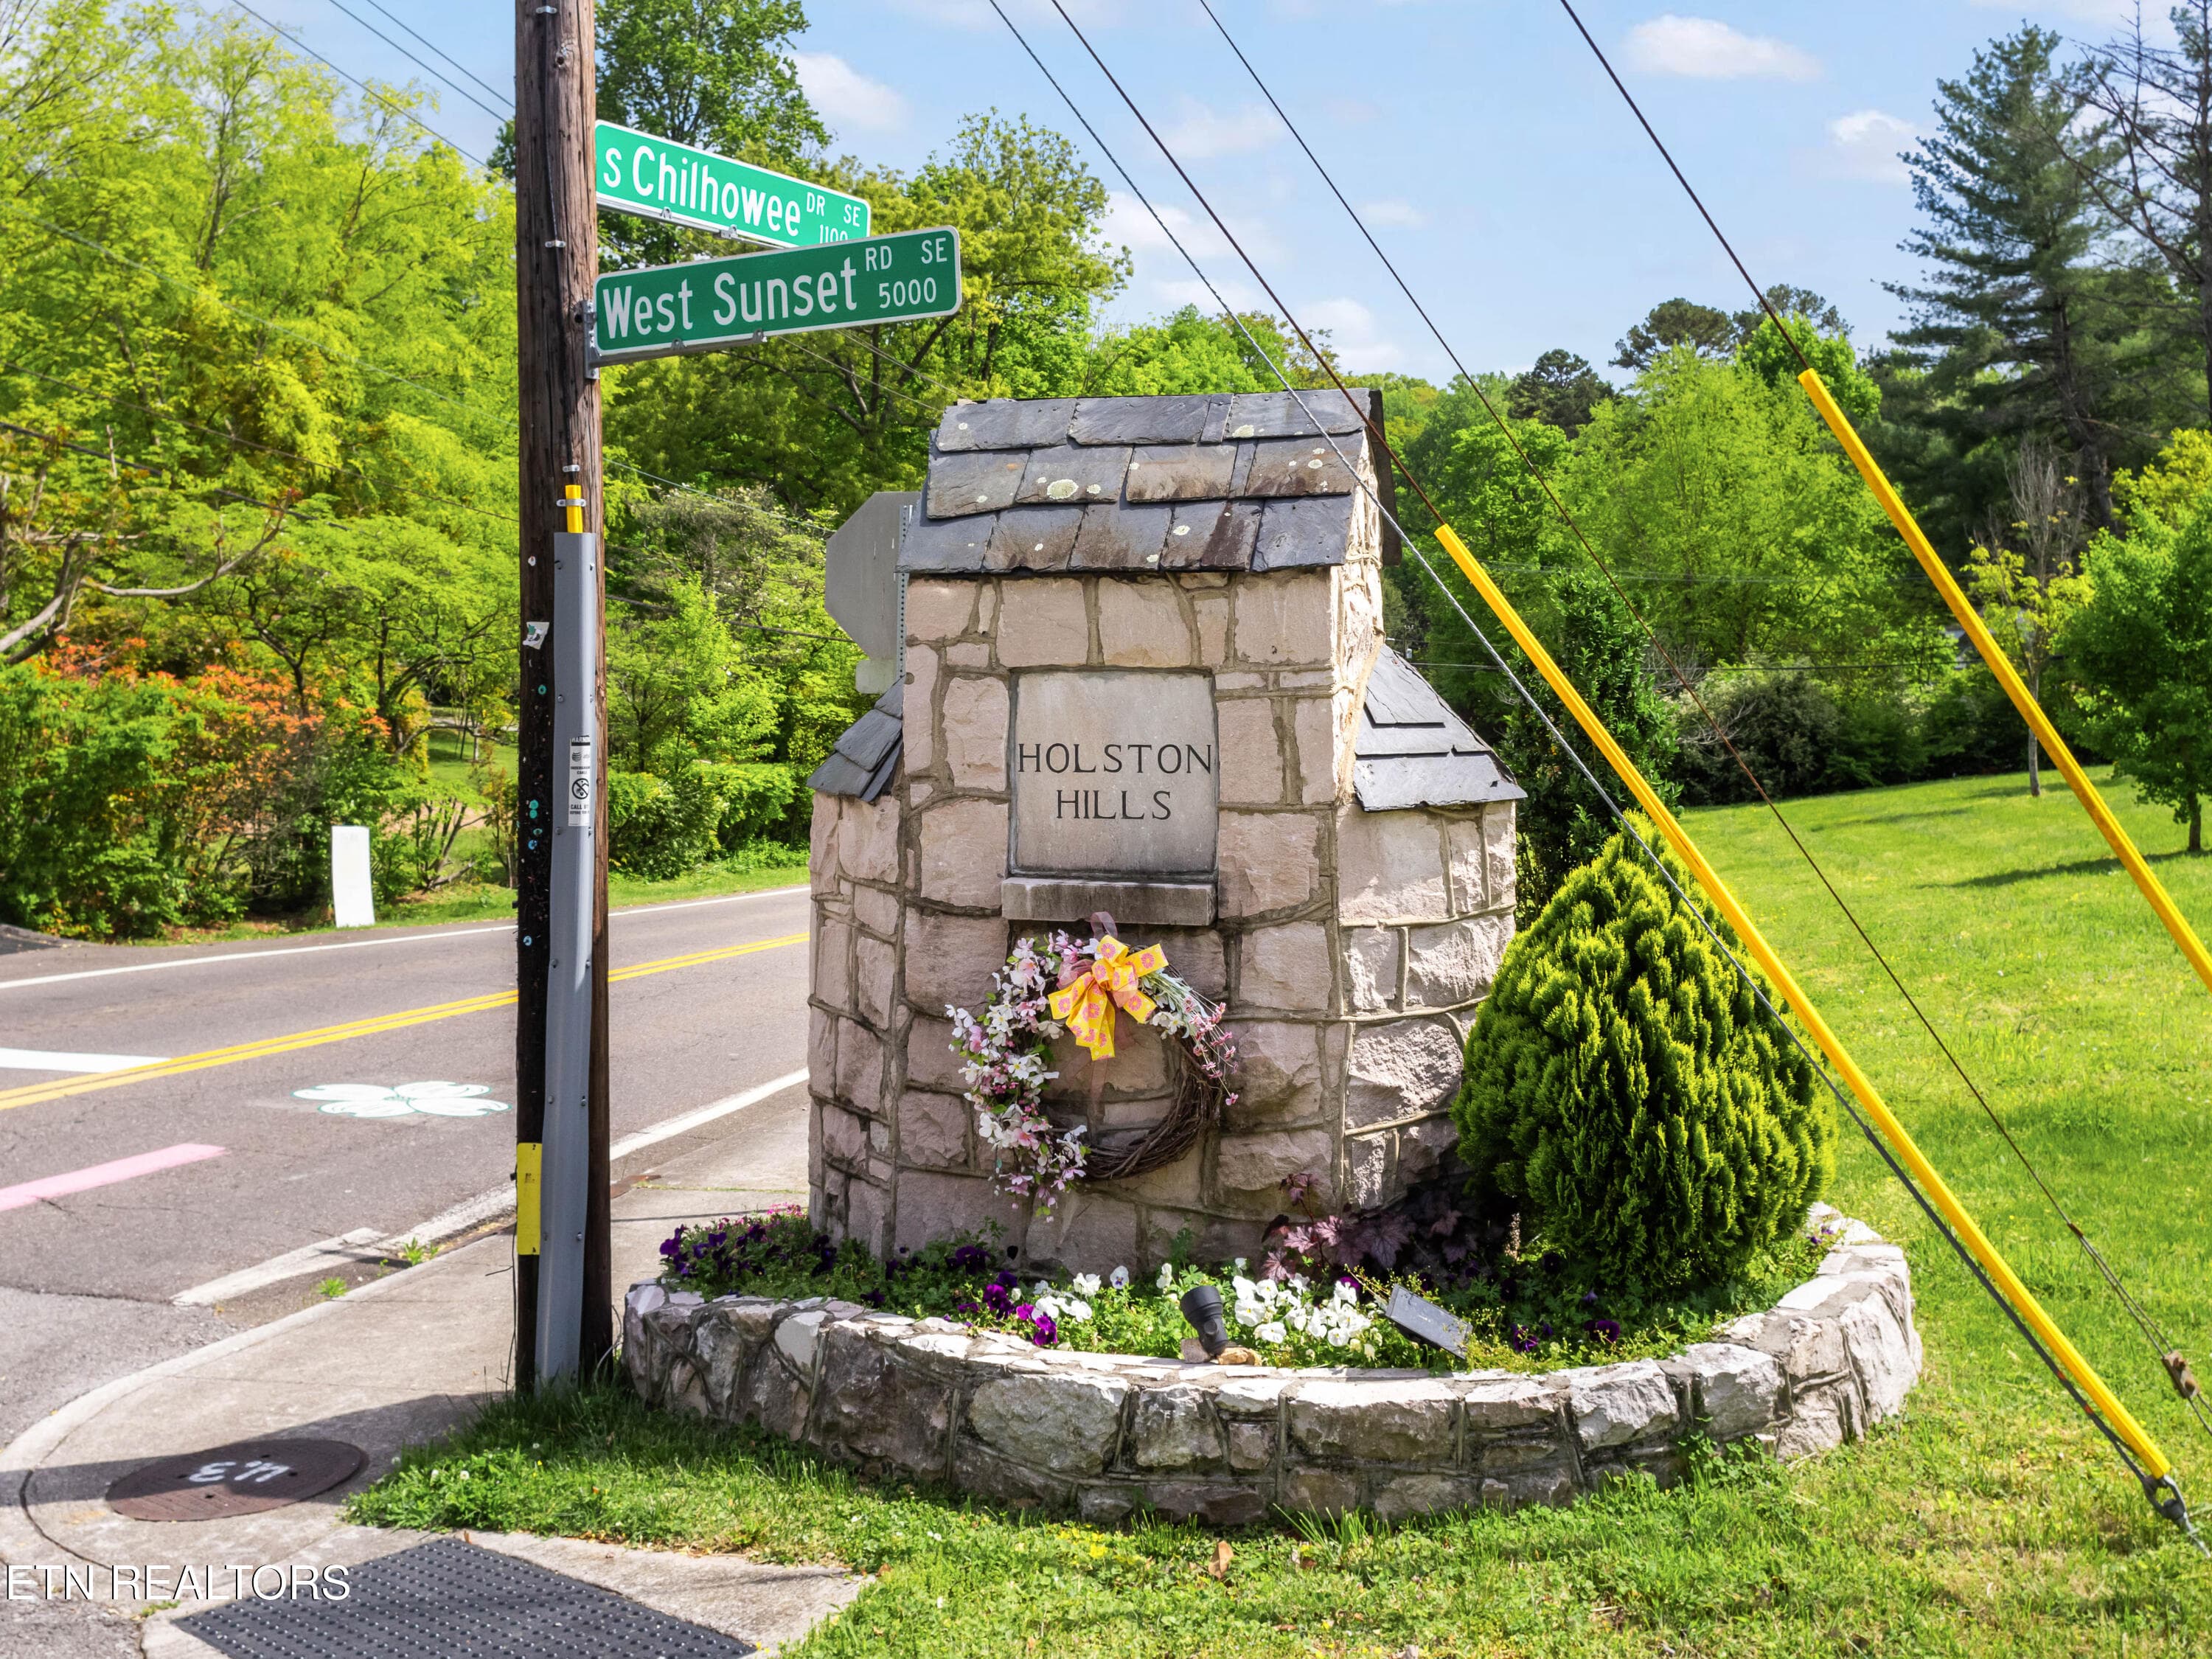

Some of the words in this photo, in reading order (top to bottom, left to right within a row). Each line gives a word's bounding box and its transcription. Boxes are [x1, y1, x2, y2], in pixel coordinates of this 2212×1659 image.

[603, 147, 623, 188] S
[632, 145, 801, 237] Chilhowee
[806, 192, 826, 217] DR
[843, 204, 862, 228] SE
[602, 277, 694, 339] West
[712, 256, 858, 326] Sunset
[865, 245, 893, 272] RD
[920, 237, 948, 264] SE
[879, 276, 937, 309] 5000
[1018, 742, 1212, 774] HOLSTON
[1056, 789, 1172, 821] HILLS
